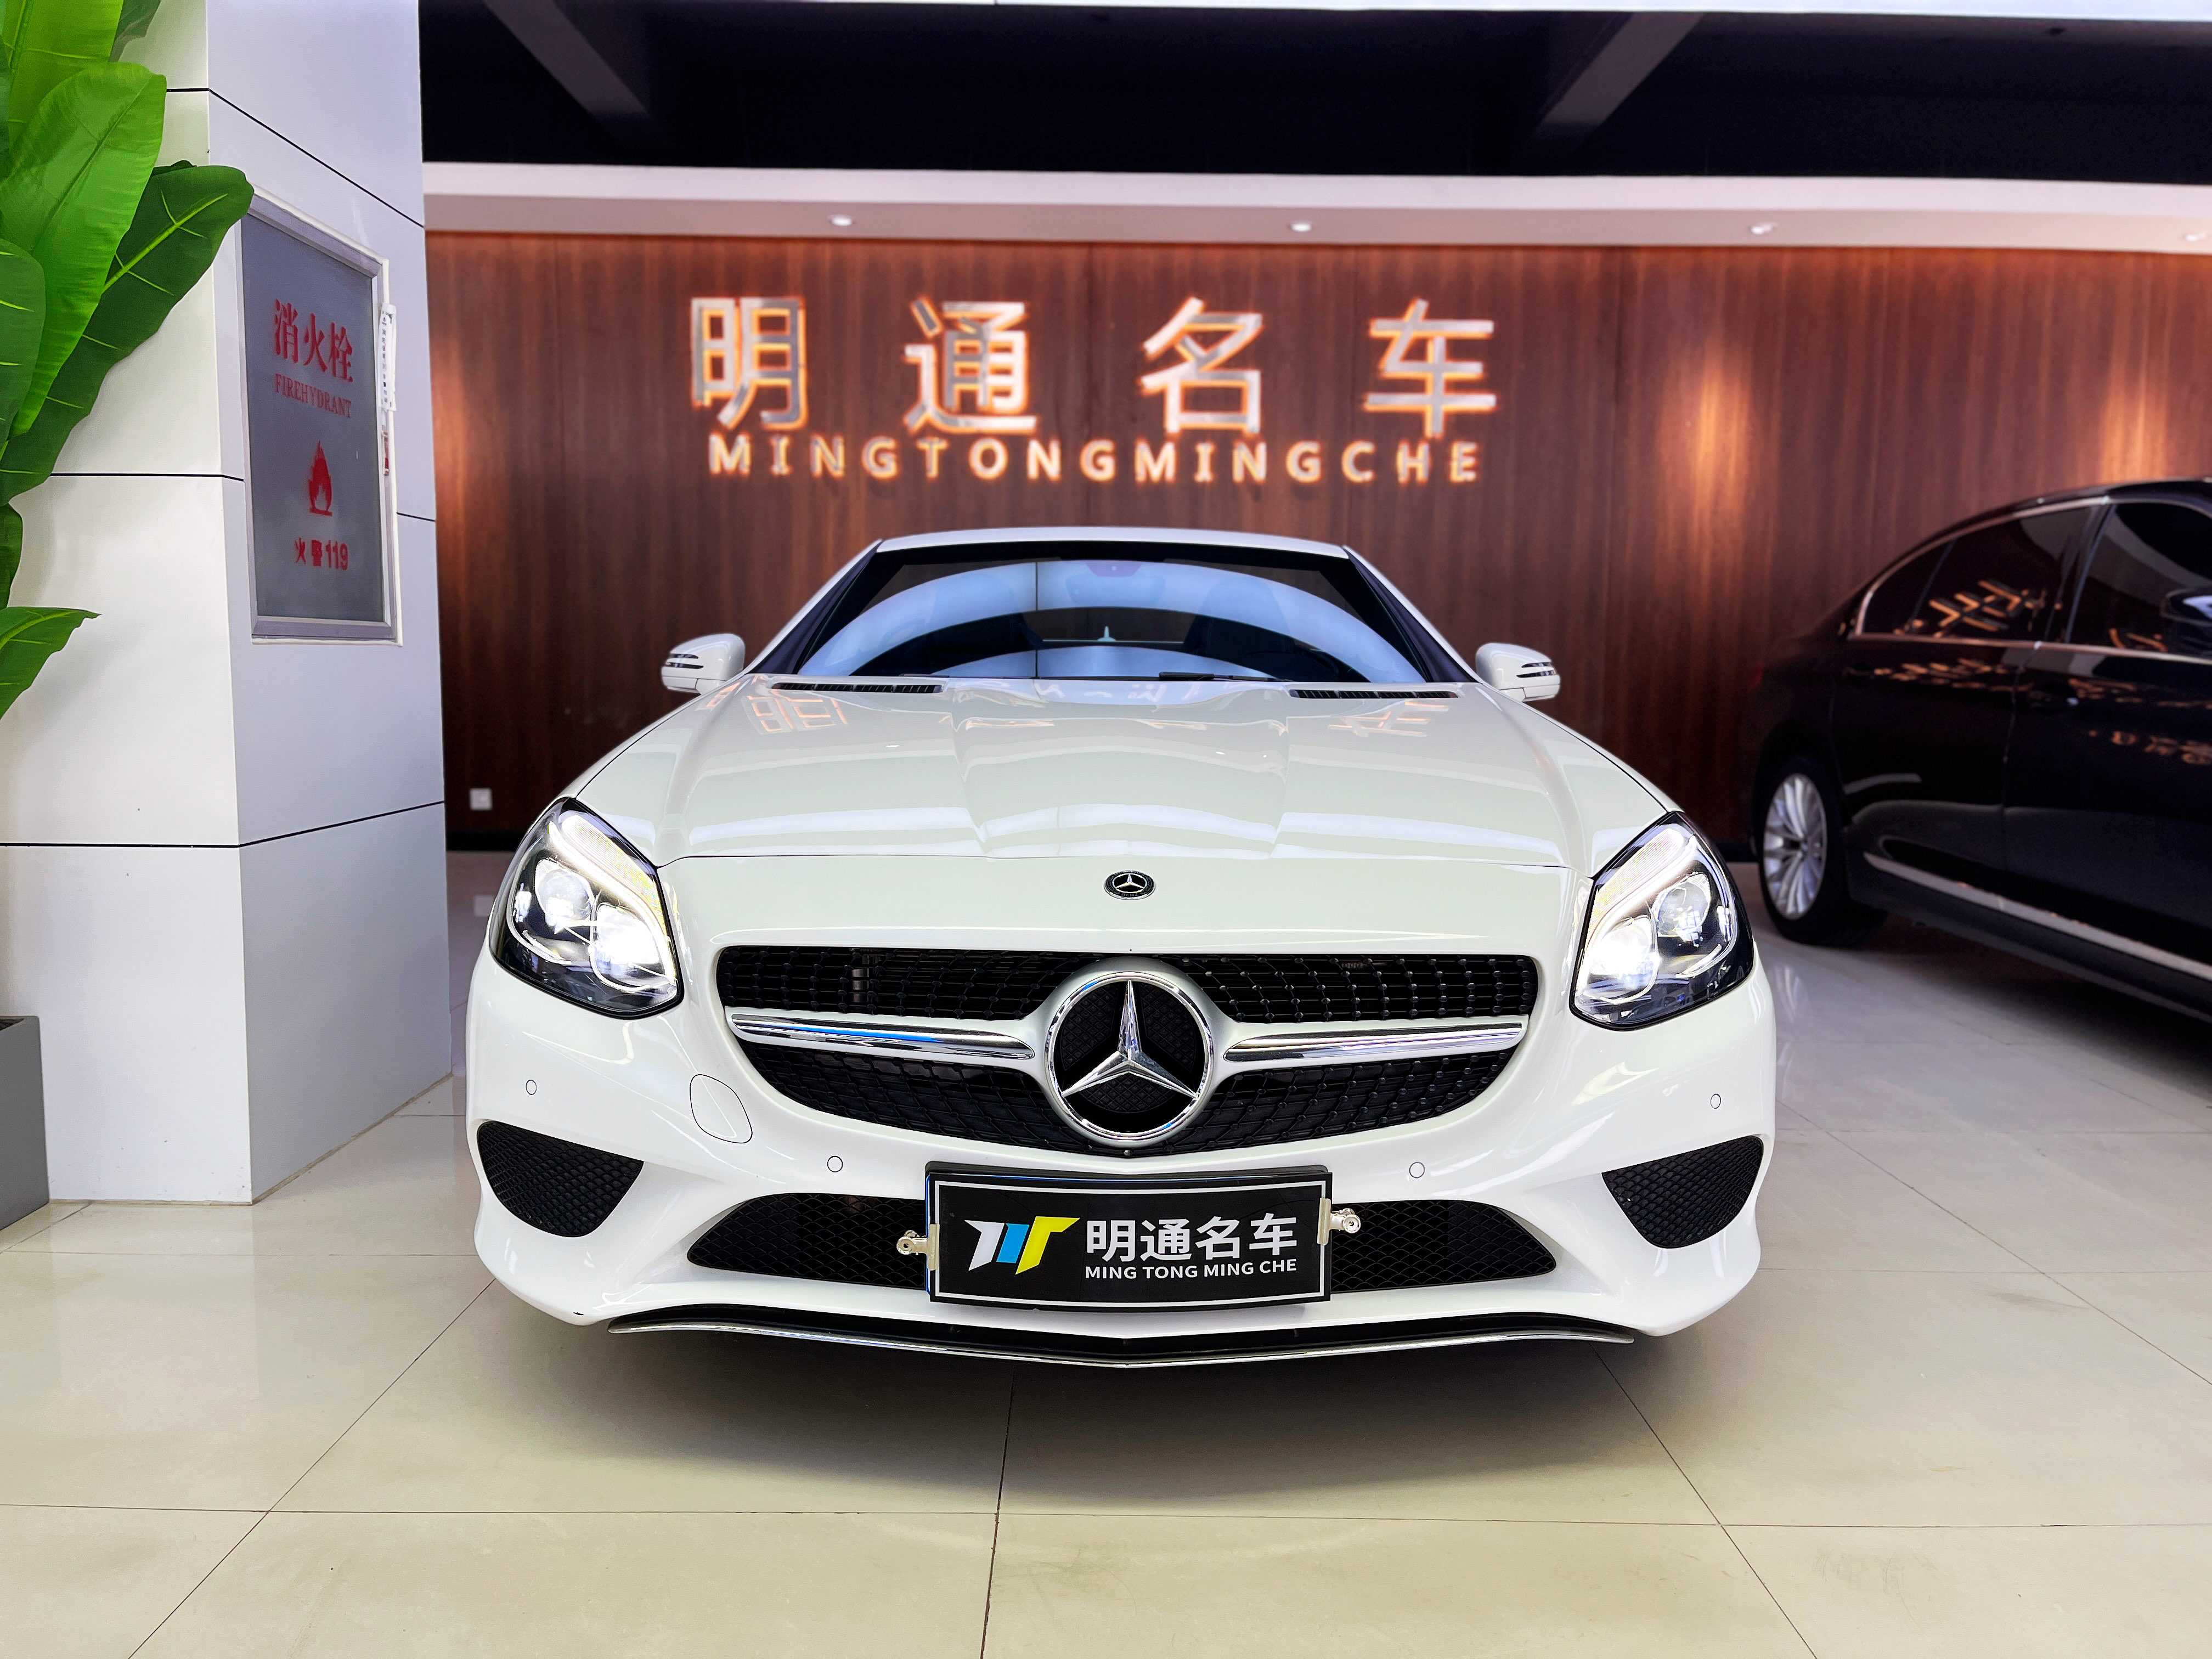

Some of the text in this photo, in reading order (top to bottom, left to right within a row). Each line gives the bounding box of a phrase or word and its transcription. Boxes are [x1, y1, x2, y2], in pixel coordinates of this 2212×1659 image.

[274, 298, 354, 383] 消火栓
[690, 296, 1497, 437] 明通名车
[274, 373, 353, 419] FIREHYDRANT
[1086, 1212, 1297, 1262] 明通名车
[1085, 1259, 1297, 1279] MING TONG MING CHE
